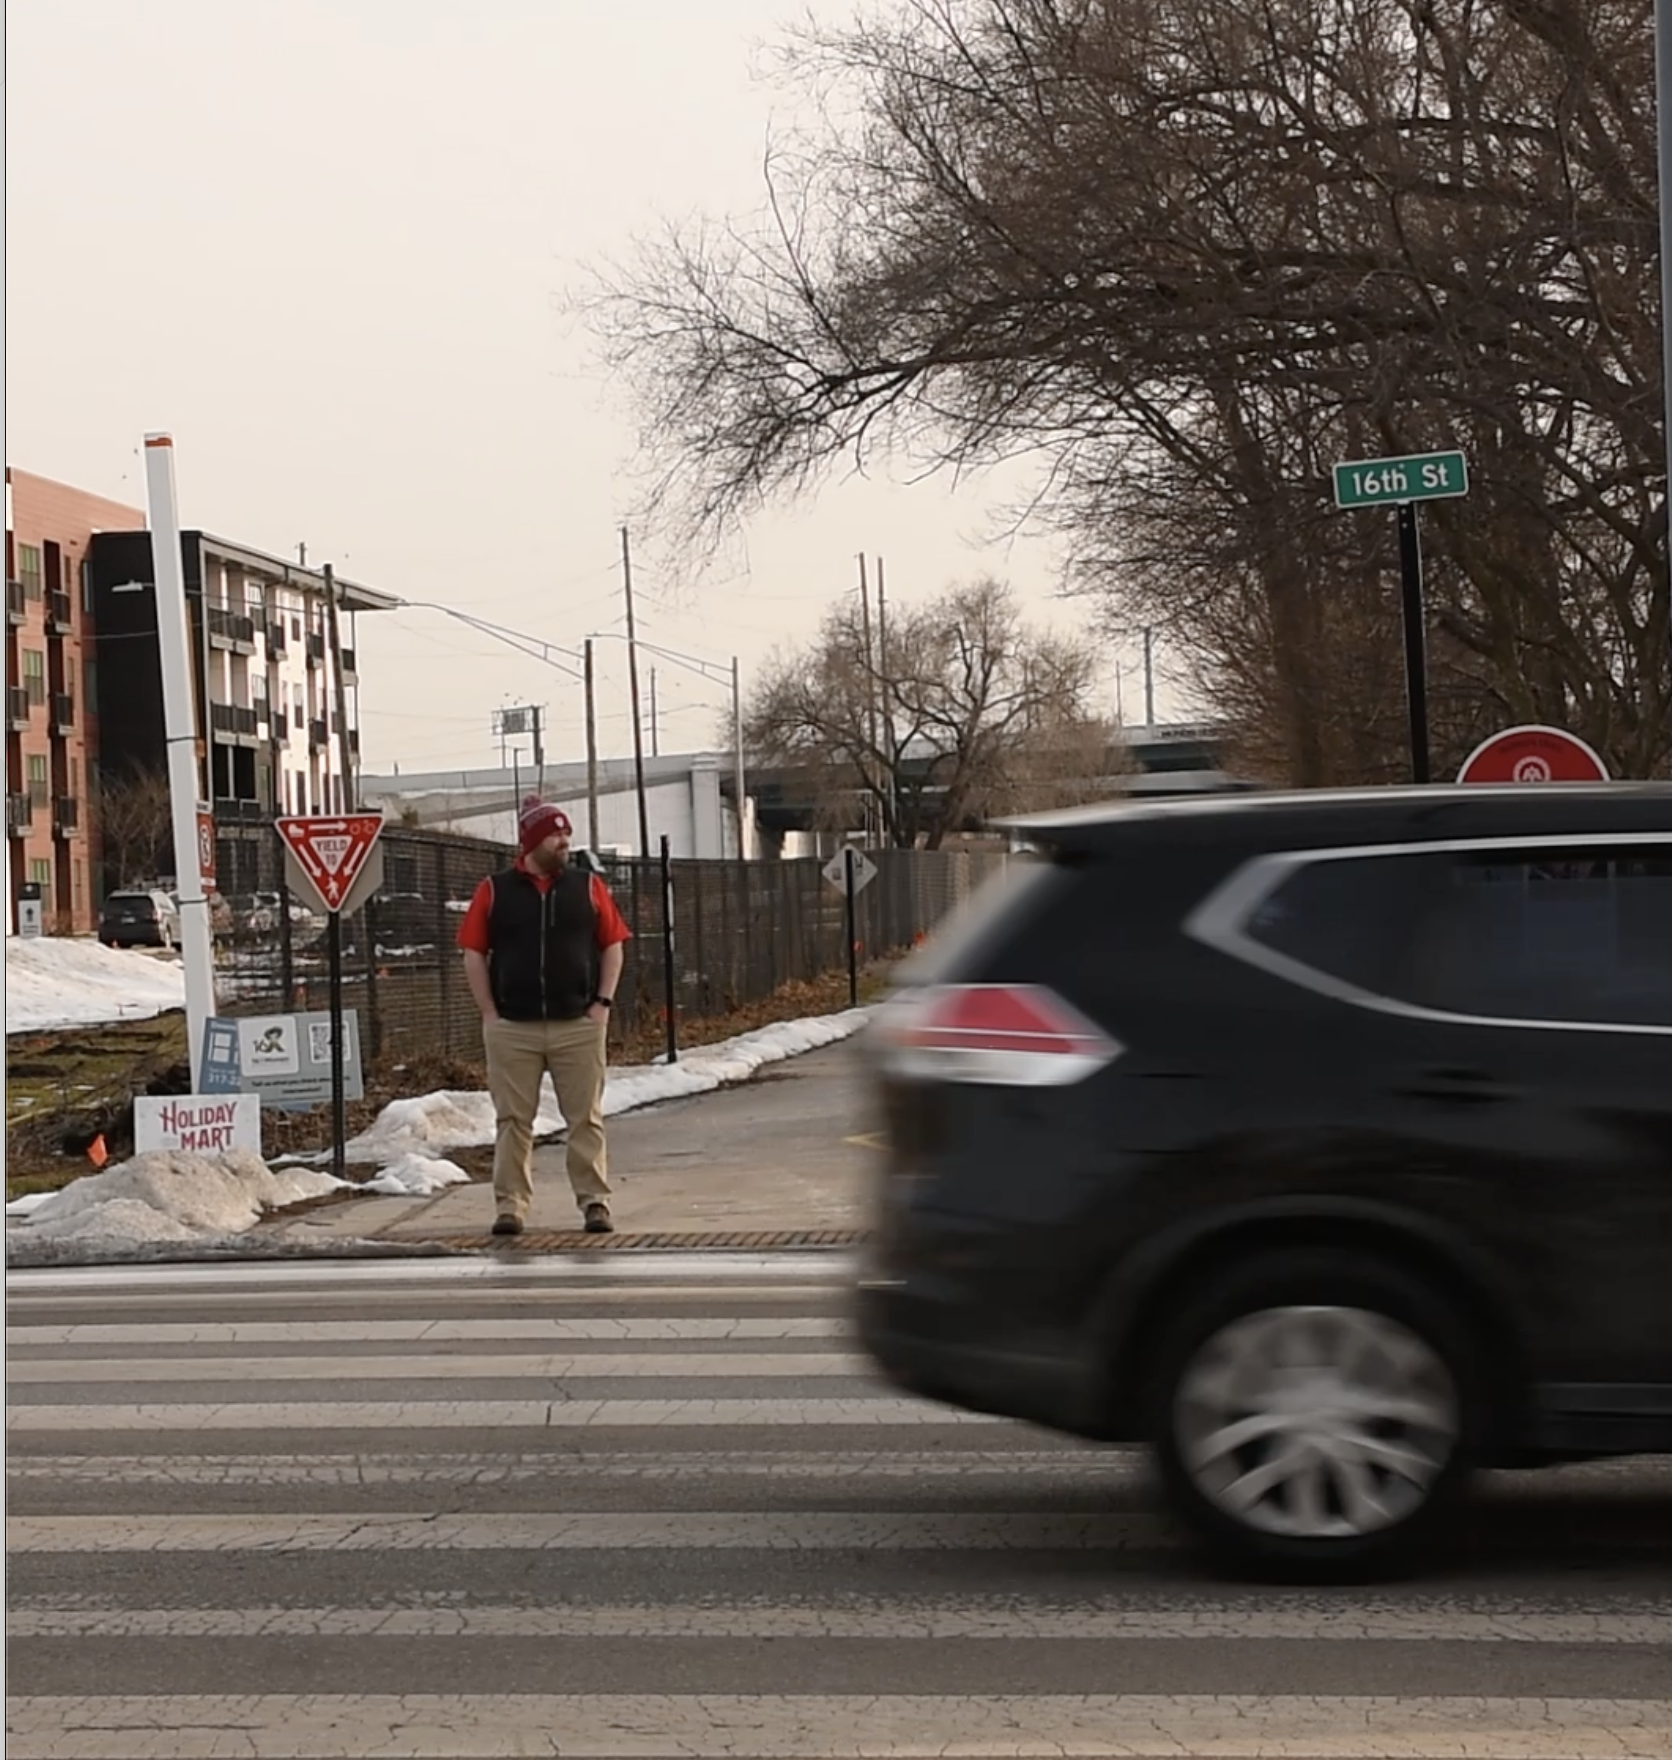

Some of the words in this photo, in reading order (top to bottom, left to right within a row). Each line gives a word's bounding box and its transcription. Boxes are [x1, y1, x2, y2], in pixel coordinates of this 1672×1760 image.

[1352, 467, 1408, 497] 16th
[1421, 462, 1449, 489] St
[314, 840, 348, 852] YIELD
[325, 853, 338, 867] TO
[158, 1100, 237, 1135] HOLIDAY
[181, 1126, 234, 1153] MART
